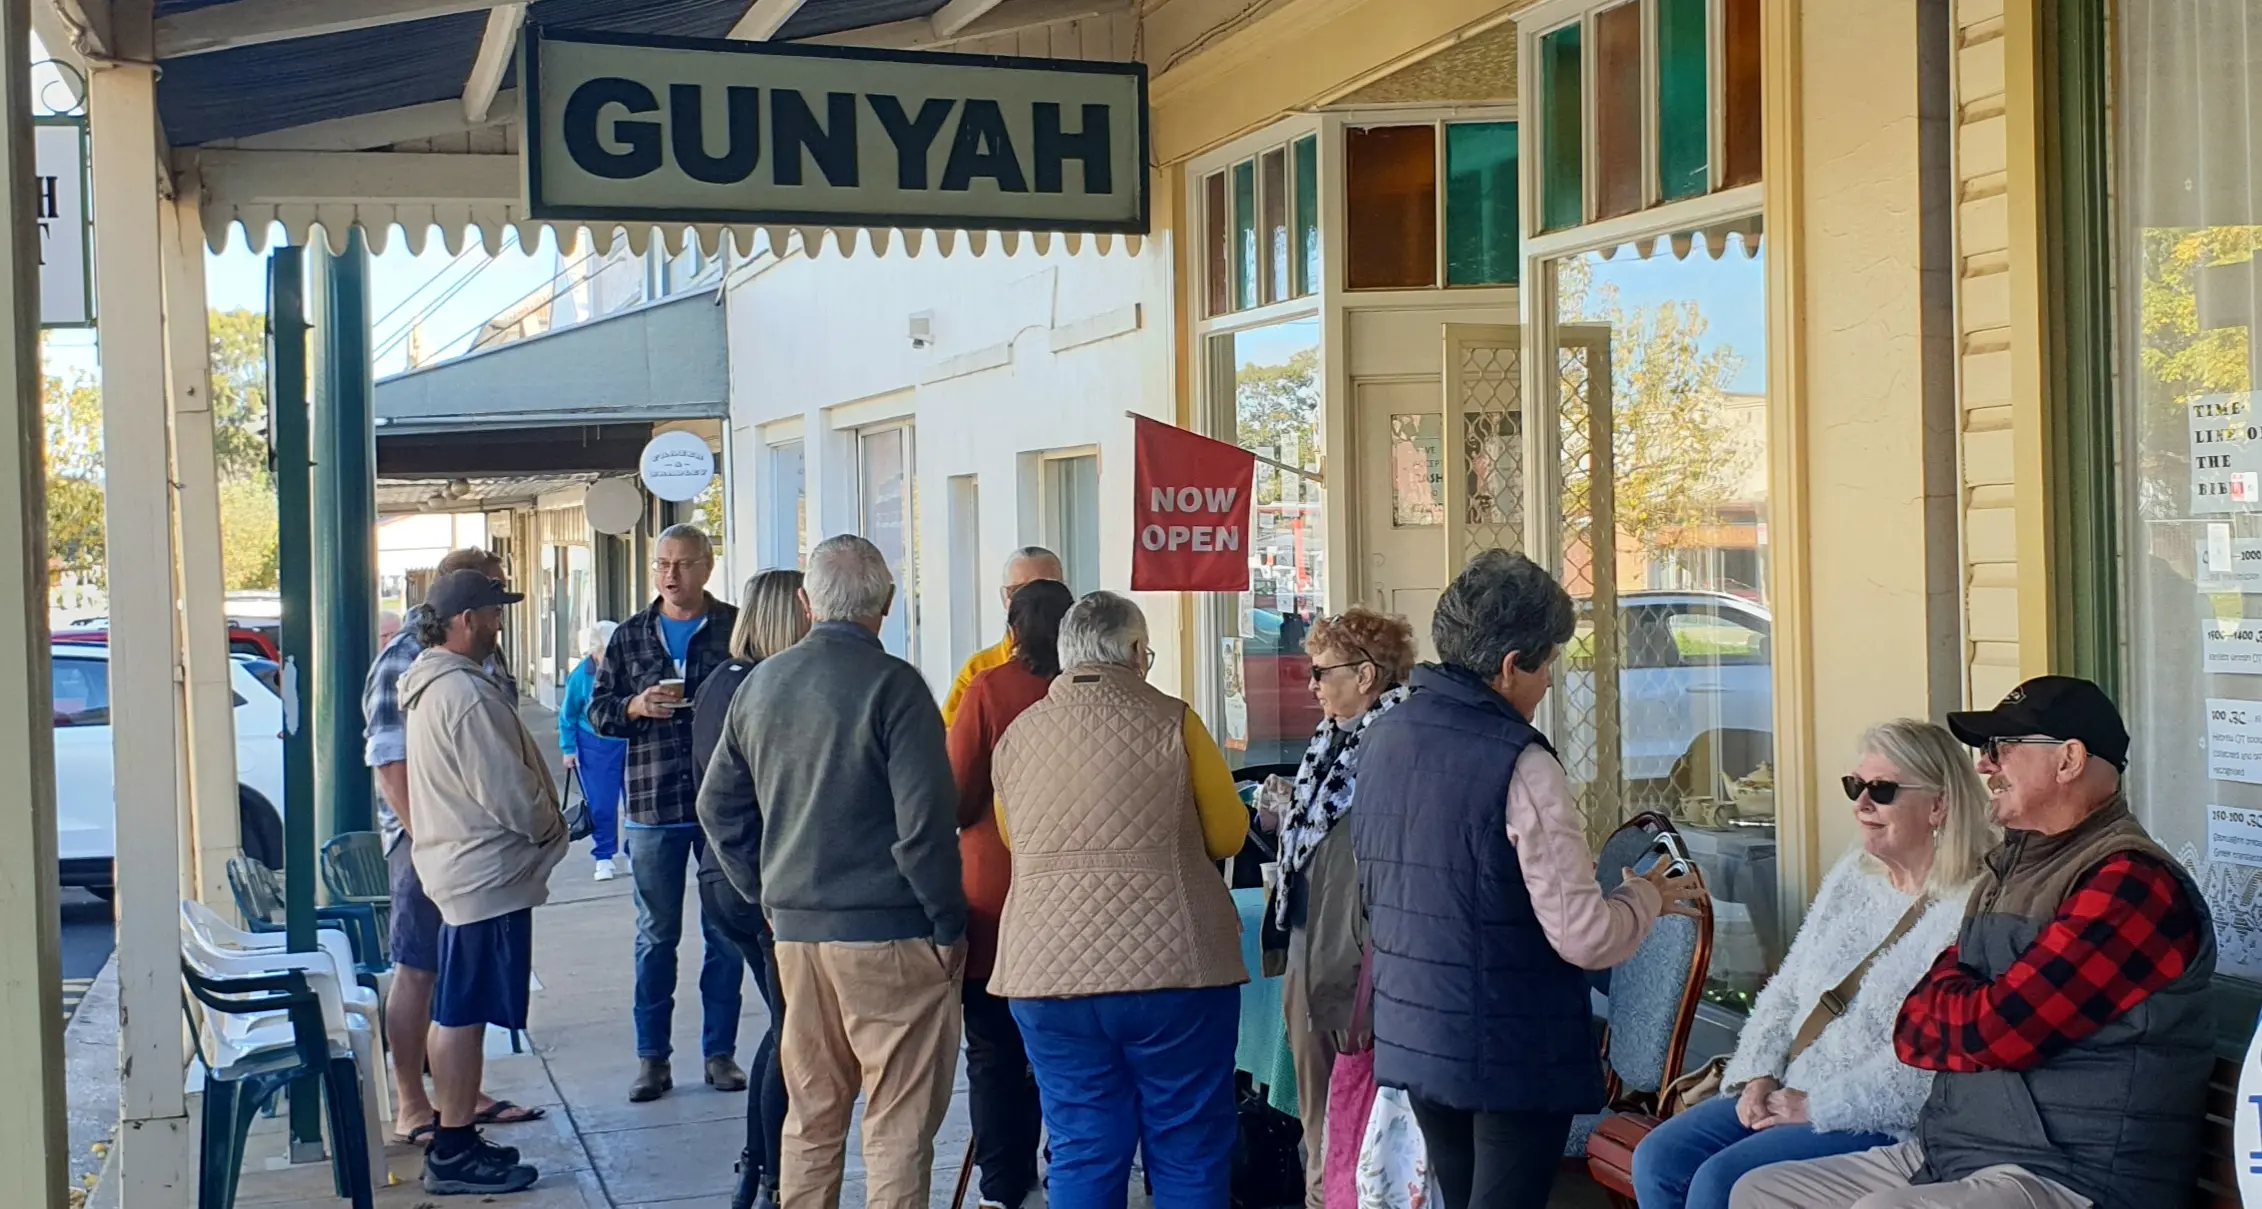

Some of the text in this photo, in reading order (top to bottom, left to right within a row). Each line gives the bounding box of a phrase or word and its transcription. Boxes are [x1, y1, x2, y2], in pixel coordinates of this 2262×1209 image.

[563, 76, 1112, 195] GUNYAH
[2247, 426, 2262, 441] O
[2195, 454, 2232, 470] THE
[1151, 486, 1237, 513] NOW
[1141, 524, 1239, 552] OPEN
